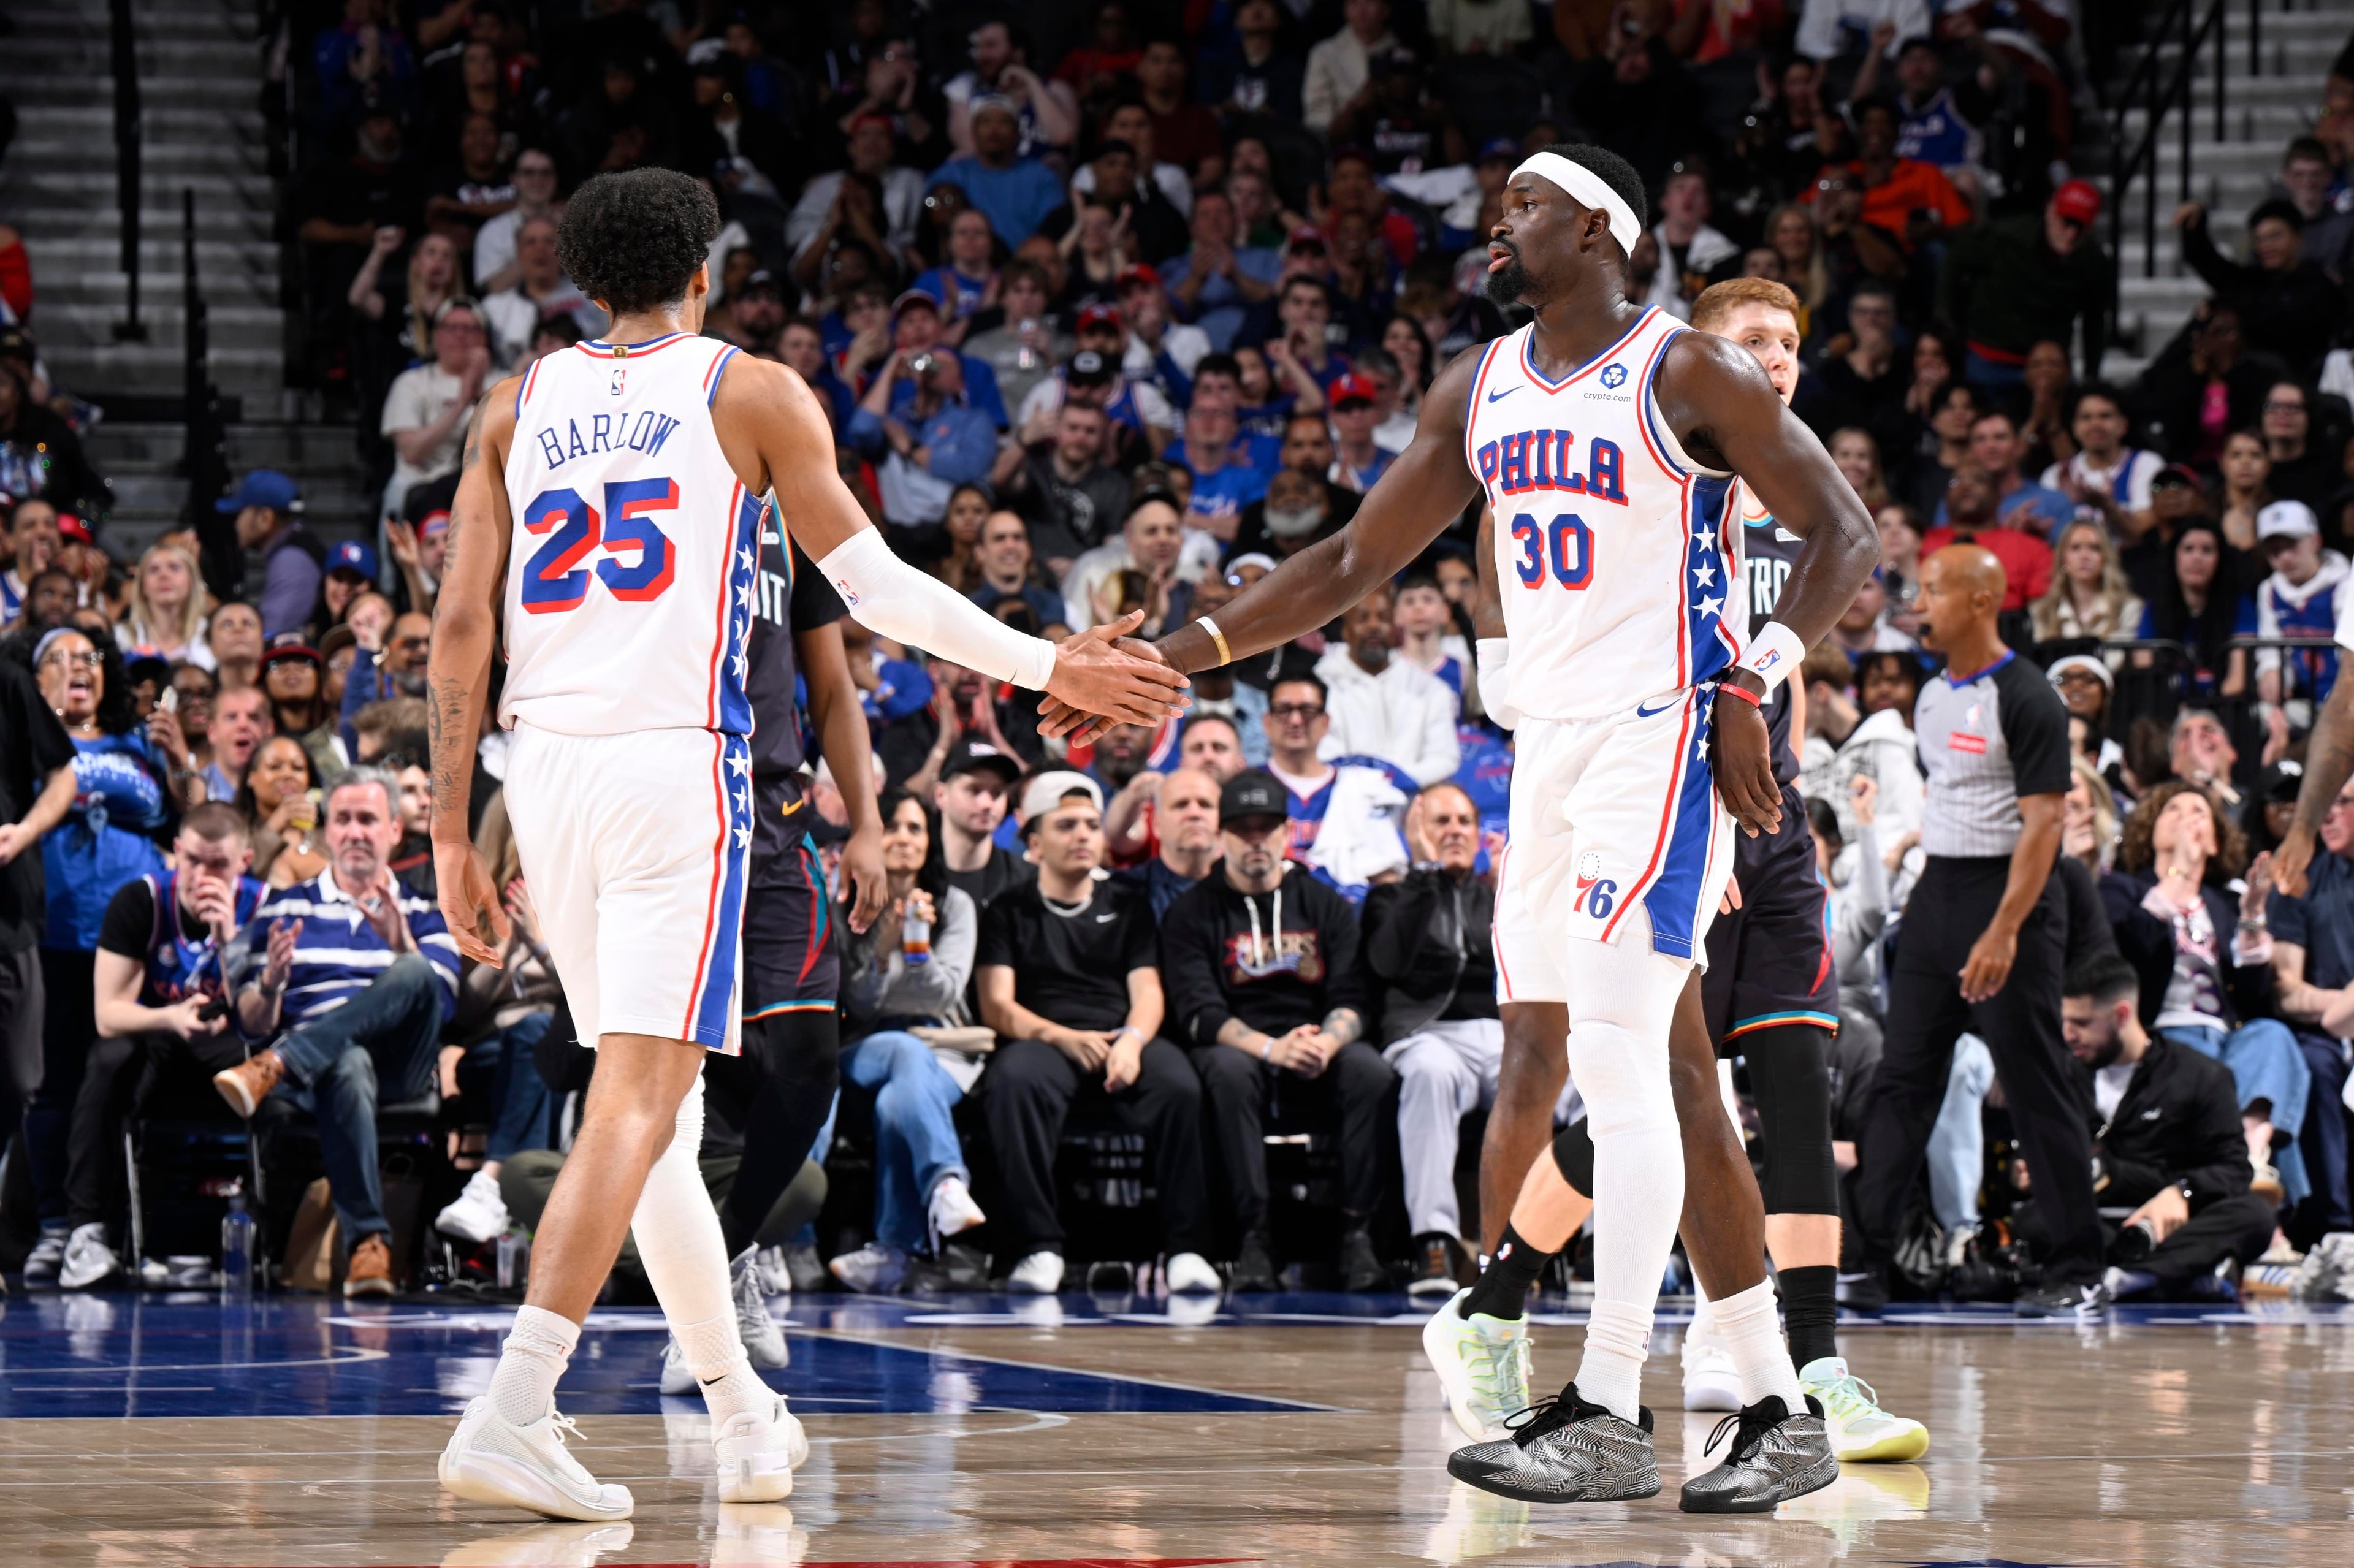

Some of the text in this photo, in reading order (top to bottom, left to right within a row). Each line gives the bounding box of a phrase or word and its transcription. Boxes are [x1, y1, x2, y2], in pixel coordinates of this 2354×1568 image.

[1583, 392, 1631, 402] crypto.com
[537, 411, 680, 470] BARLOW
[1477, 428, 1629, 509] PHILA
[521, 476, 680, 615] 25
[1511, 513, 1594, 591] 30
[753, 569, 786, 626] IT
[1573, 872, 1617, 919] 76
